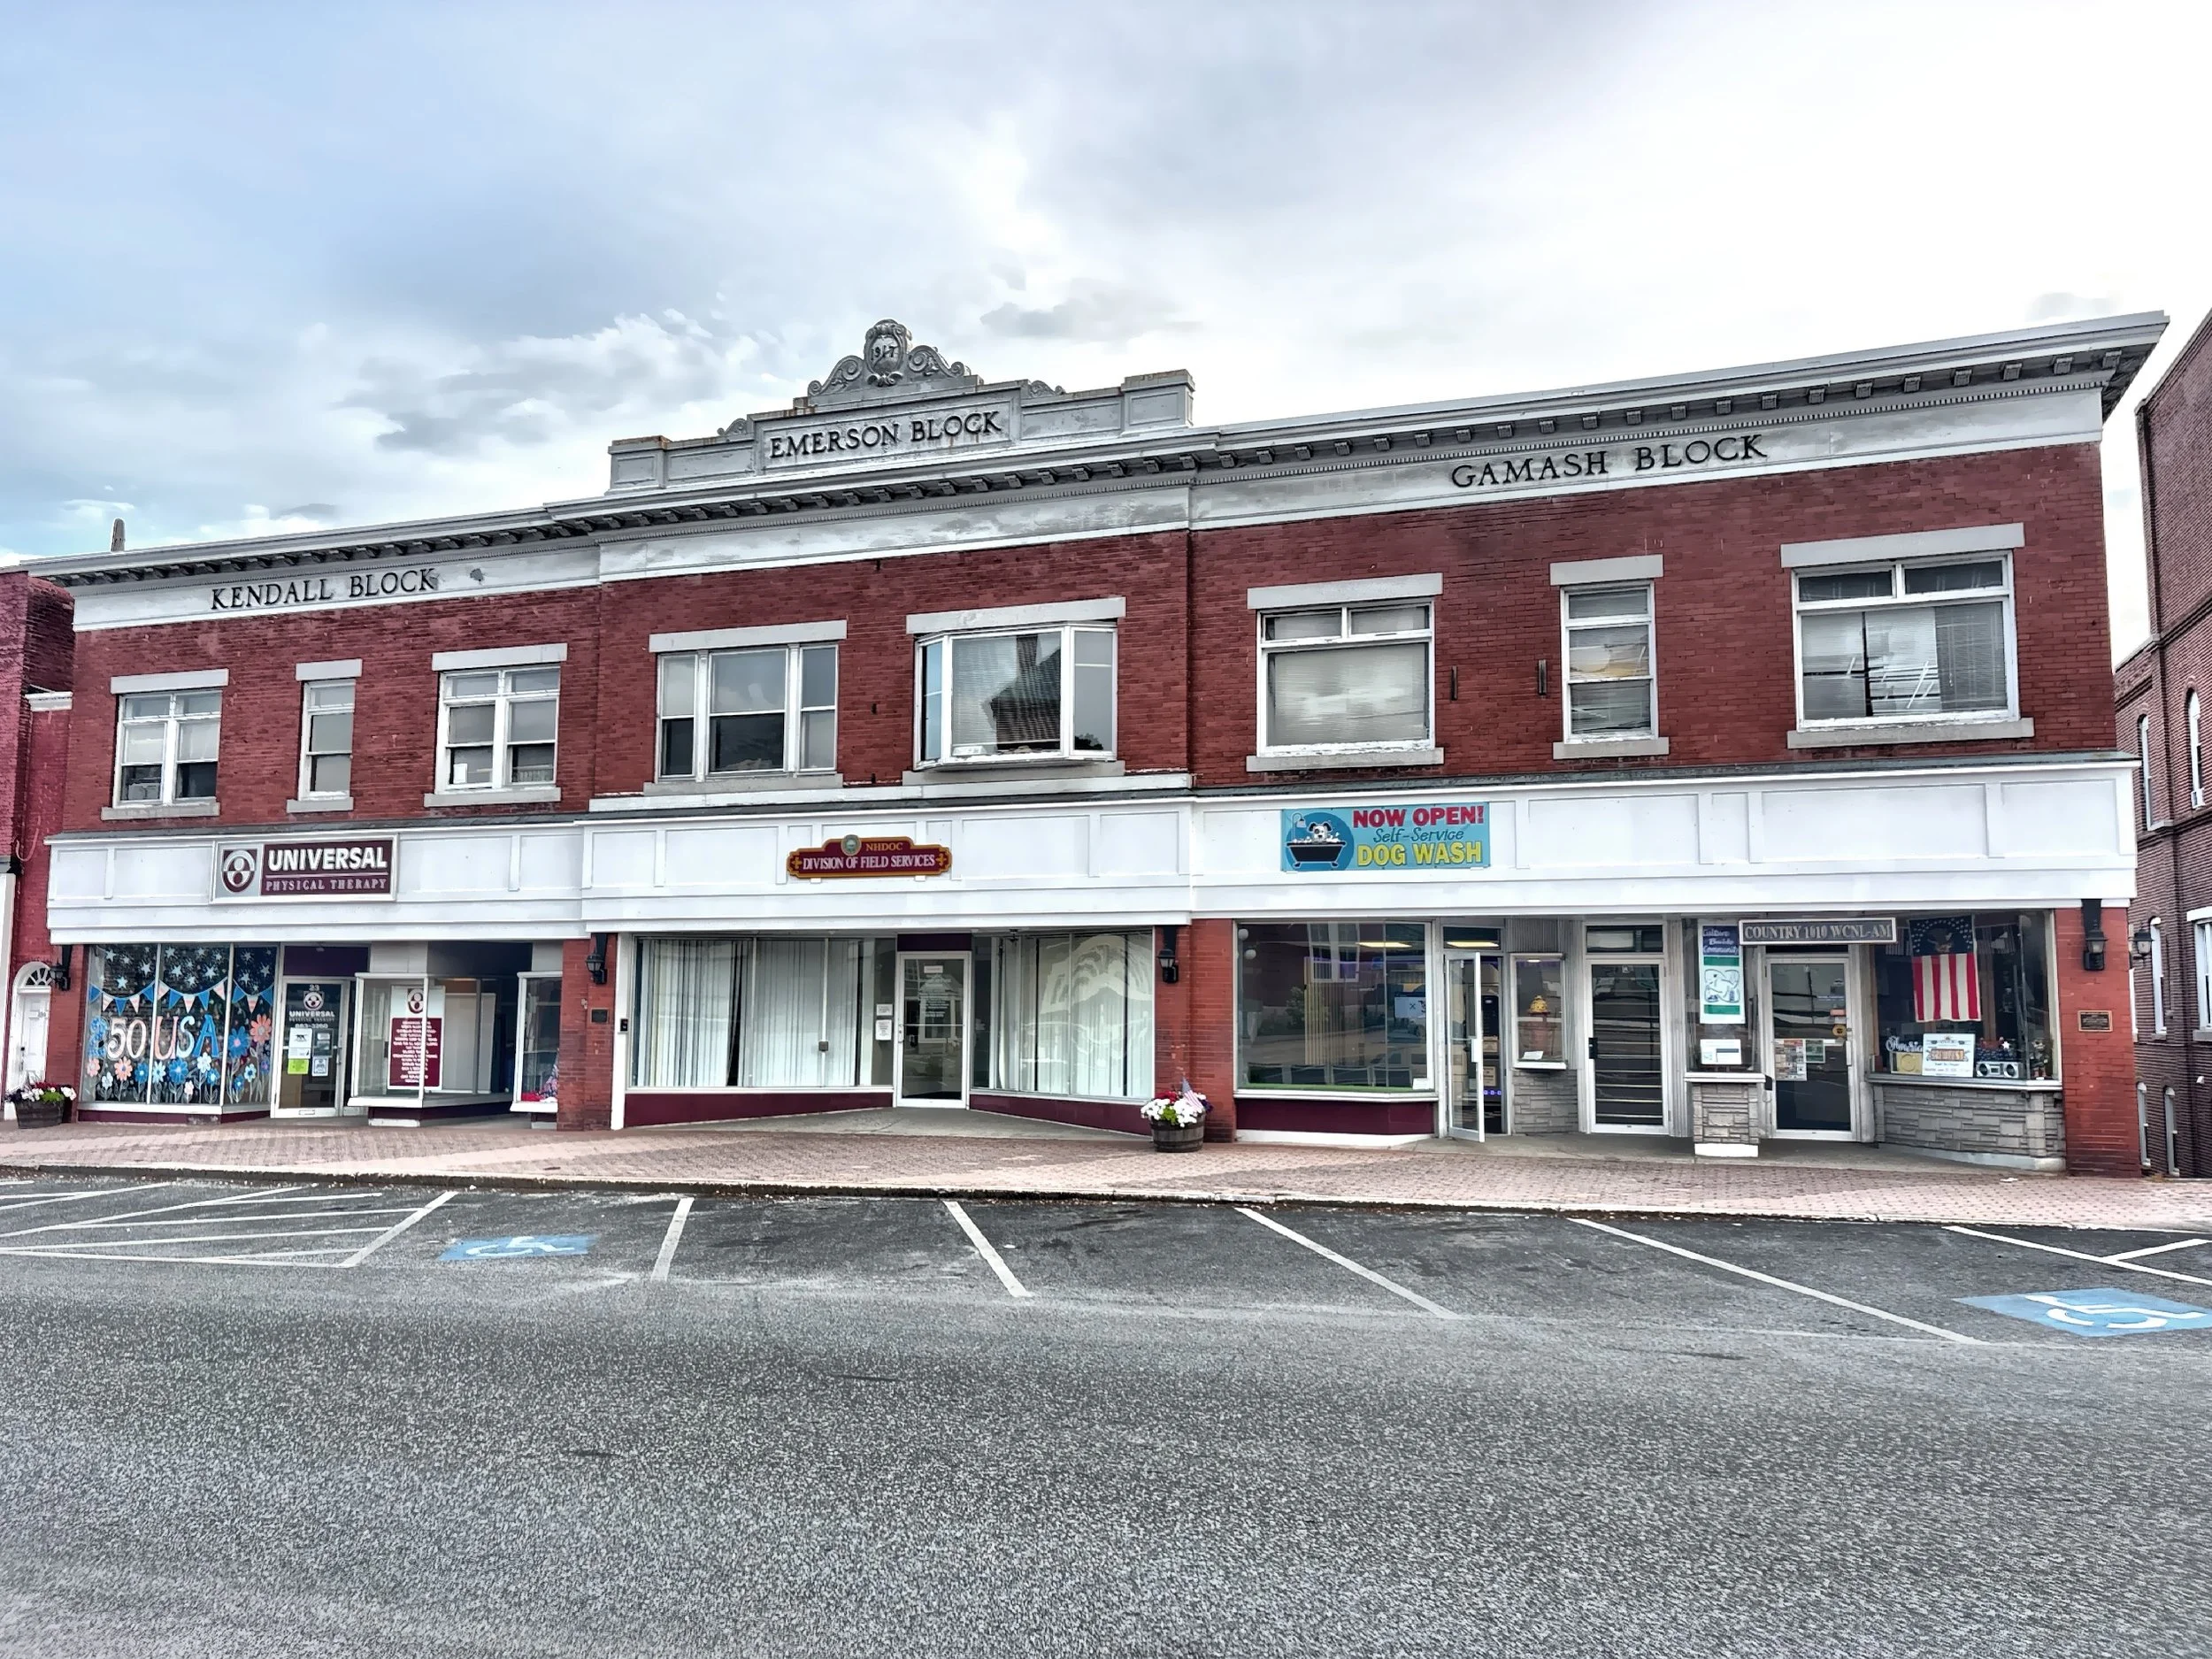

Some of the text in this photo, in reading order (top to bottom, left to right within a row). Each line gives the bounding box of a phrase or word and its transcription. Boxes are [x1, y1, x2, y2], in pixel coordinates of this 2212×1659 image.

[770, 411, 1002, 458] EMERSON BLOCK
[1451, 434, 1767, 488] GAMASH BLOCK
[210, 567, 439, 611] KENDALL BLOCK
[1352, 805, 1485, 828] NOW OPEN!
[864, 842, 903, 851] NHDOC
[1372, 826, 1464, 843] Self-Service
[267, 847, 388, 872] UNIVERSAL
[803, 854, 935, 870] DIVISION OF FIELD SERVICES
[1356, 841, 1483, 867] DOG WASH
[265, 878, 387, 892] PHYSICAL THERAPY
[1744, 924, 1893, 940] COUNTRY 1010 WCNL-AM
[154, 1014, 219, 1061] USA
